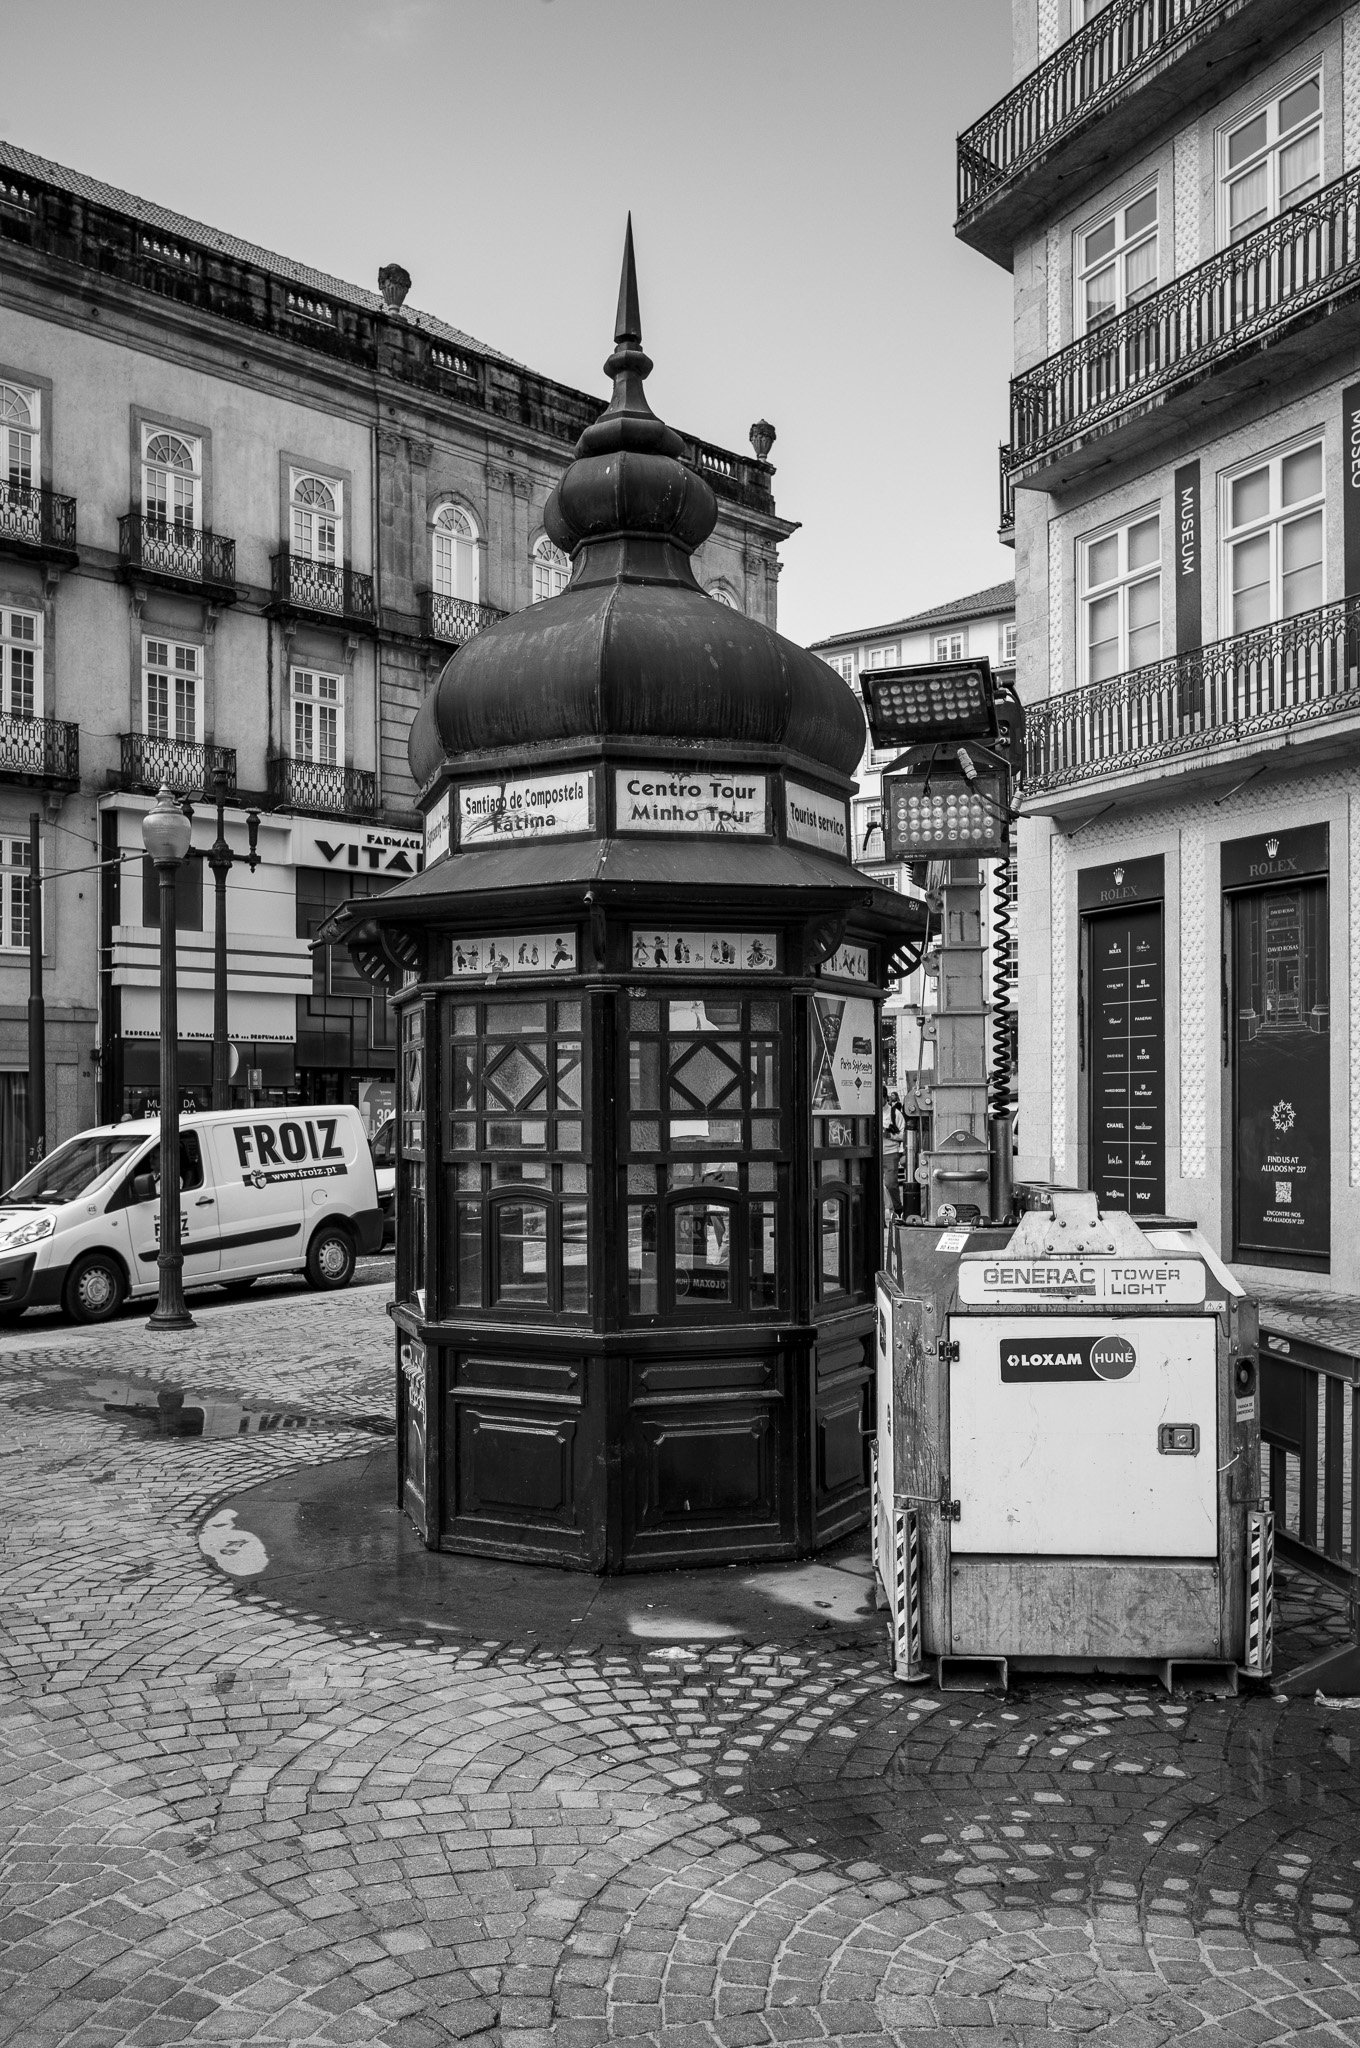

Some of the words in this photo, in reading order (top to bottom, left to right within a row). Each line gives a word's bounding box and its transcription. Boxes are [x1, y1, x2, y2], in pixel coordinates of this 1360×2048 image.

[1181, 487, 1194, 575] MUSEUM
[627, 779, 702, 797] Centro
[709, 782, 757, 799] Tour
[466, 794, 507, 815] Santiago
[510, 791, 522, 809] de
[525, 782, 583, 808] Compostela
[631, 804, 699, 821] Minho
[707, 806, 754, 823] Tour
[790, 802, 817, 828] Tourist
[818, 816, 844, 837] service
[1249, 857, 1297, 877] ROLEX
[1100, 886, 1138, 902] ROLEX
[183, 1100, 195, 1108] DA
[233, 1119, 344, 1168] FROIZ
[1291, 1156, 1299, 1164] AT
[271, 1166, 338, 1181] www.froiz.pt
[984, 1268, 1096, 1285] GENERAC
[1111, 1269, 1180, 1280] TOWER
[1111, 1284, 1166, 1295] LIGHT
[1021, 1353, 1082, 1366] LOXAM
[1095, 1352, 1133, 1364] HUNE
